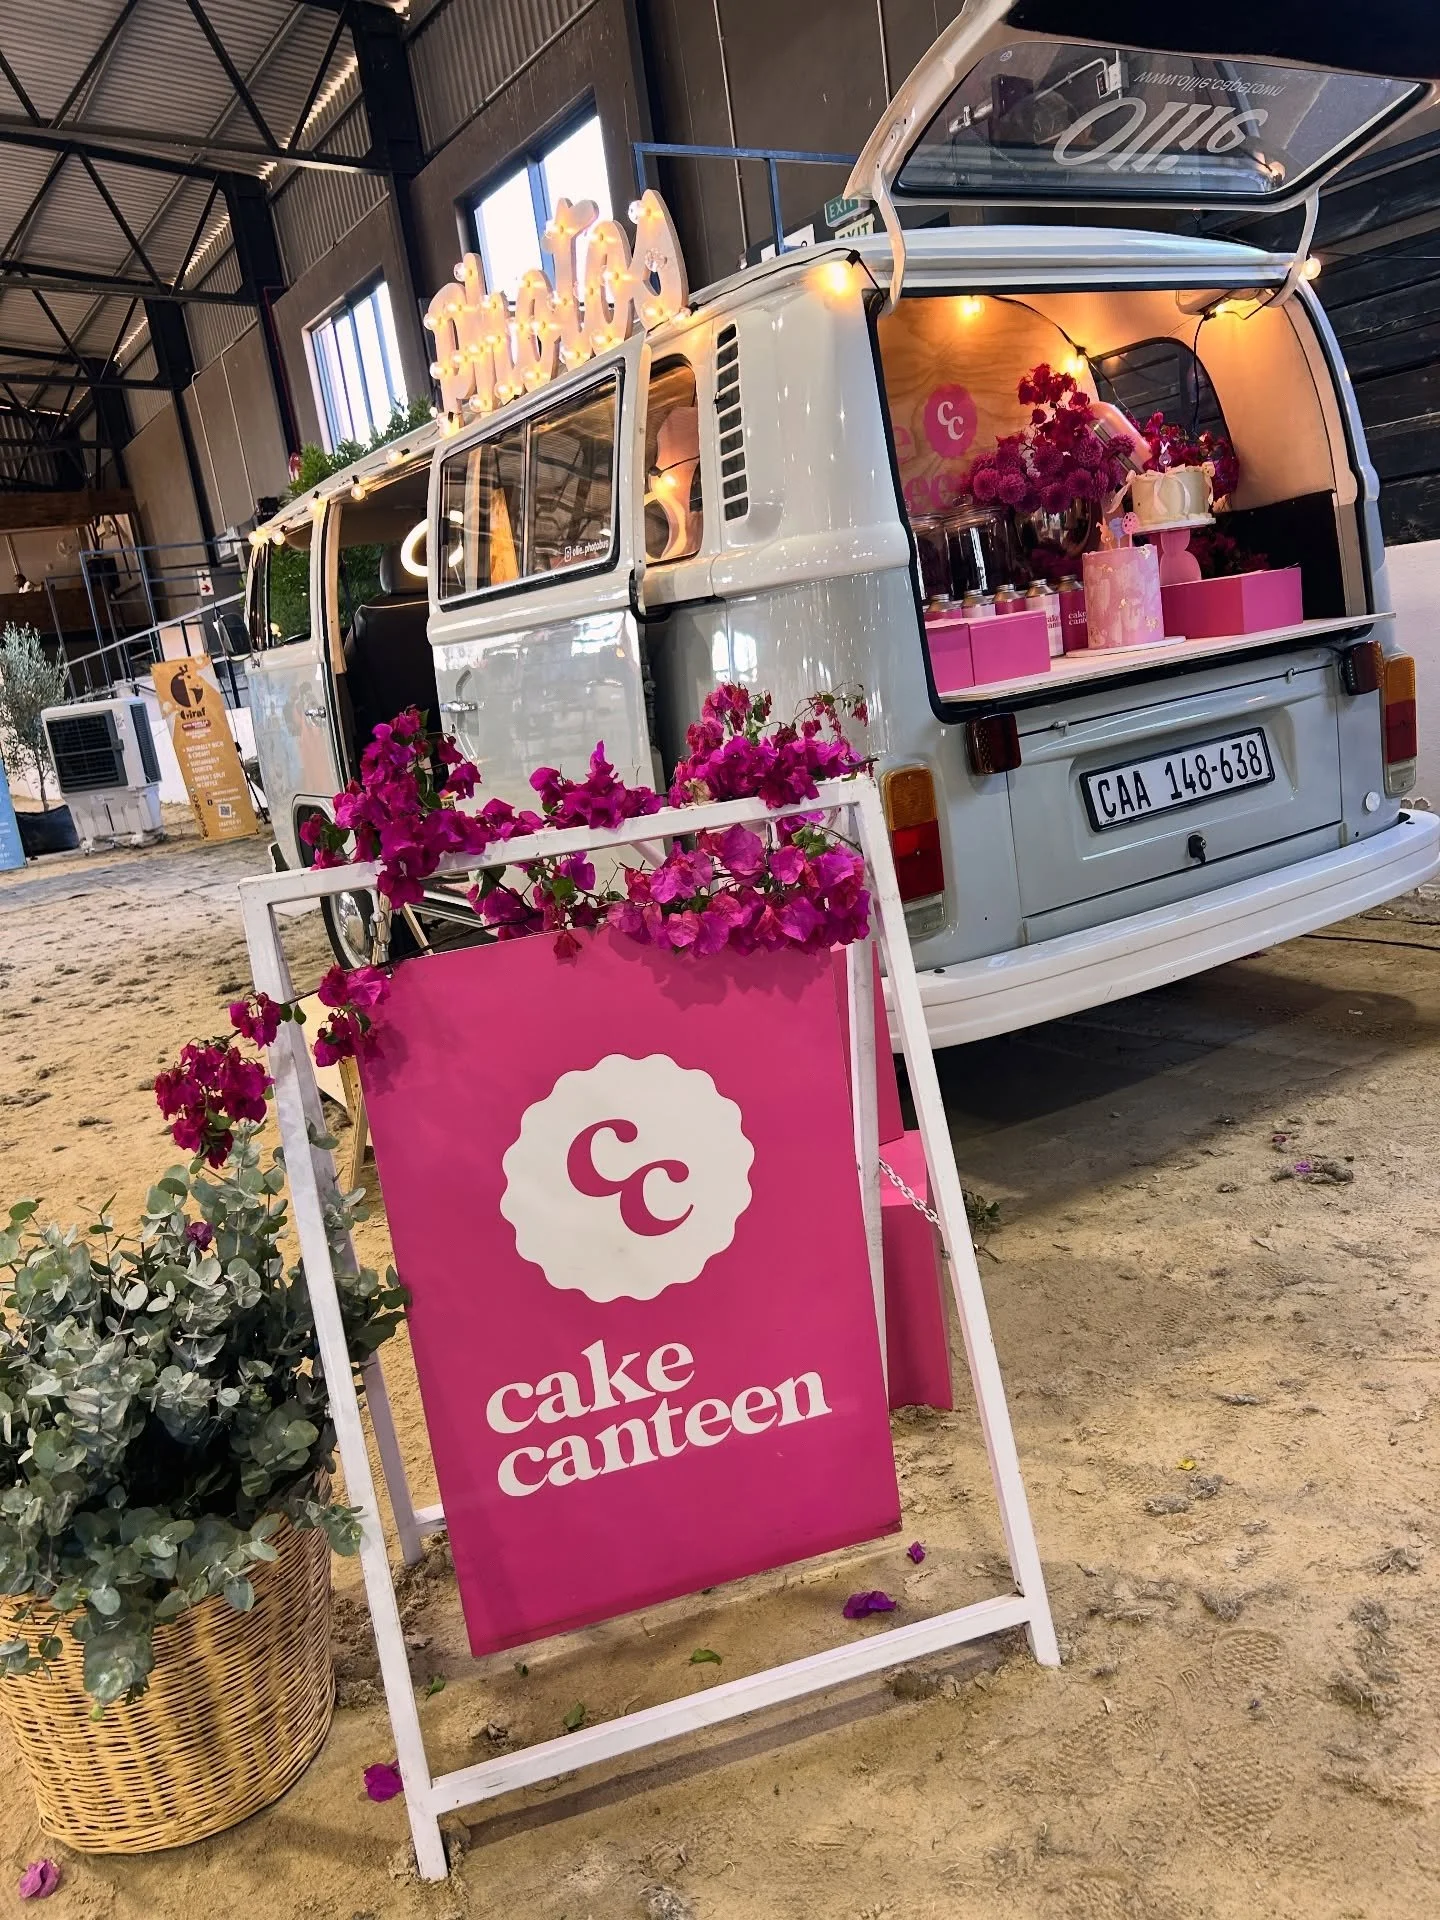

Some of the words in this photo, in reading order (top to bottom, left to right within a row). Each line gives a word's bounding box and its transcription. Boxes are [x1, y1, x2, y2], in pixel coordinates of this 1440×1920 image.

[839, 221, 869, 239] IT
[1097, 770, 1152, 818] CAA
[1164, 739, 1263, 800] 148-638
[486, 1339, 695, 1434] cake
[498, 1371, 832, 1497] canteen
